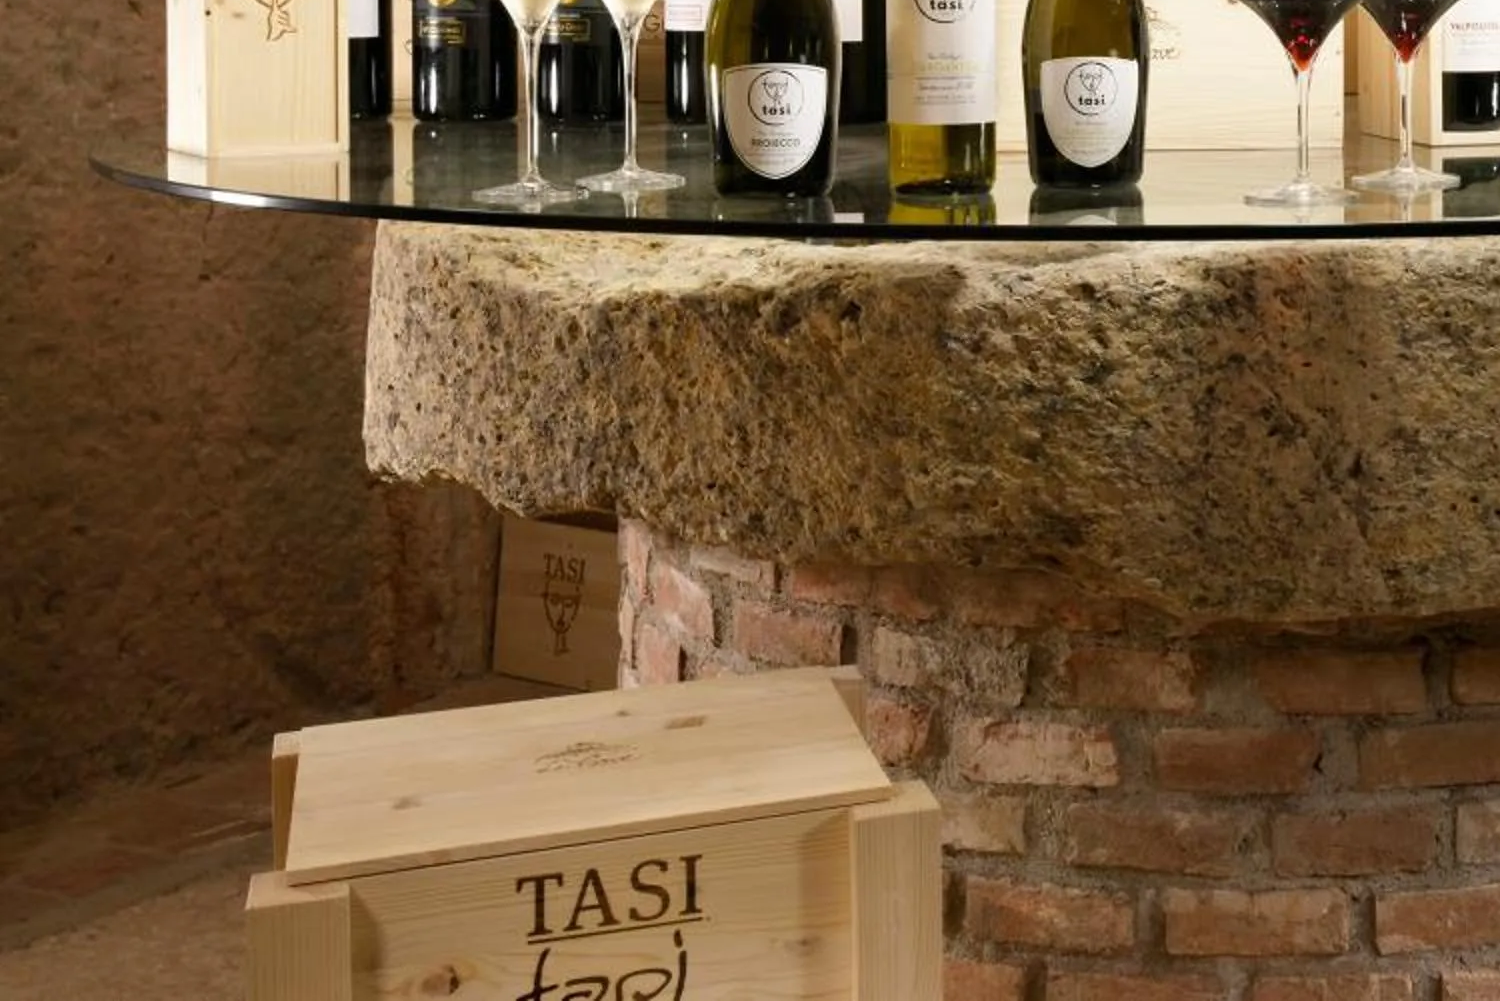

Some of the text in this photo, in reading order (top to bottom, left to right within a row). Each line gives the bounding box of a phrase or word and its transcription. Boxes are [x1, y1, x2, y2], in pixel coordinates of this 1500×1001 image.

[762, 103, 791, 116] tasi
[1078, 94, 1106, 106] tasi
[542, 553, 587, 580] TASI
[516, 854, 704, 937] TASI
